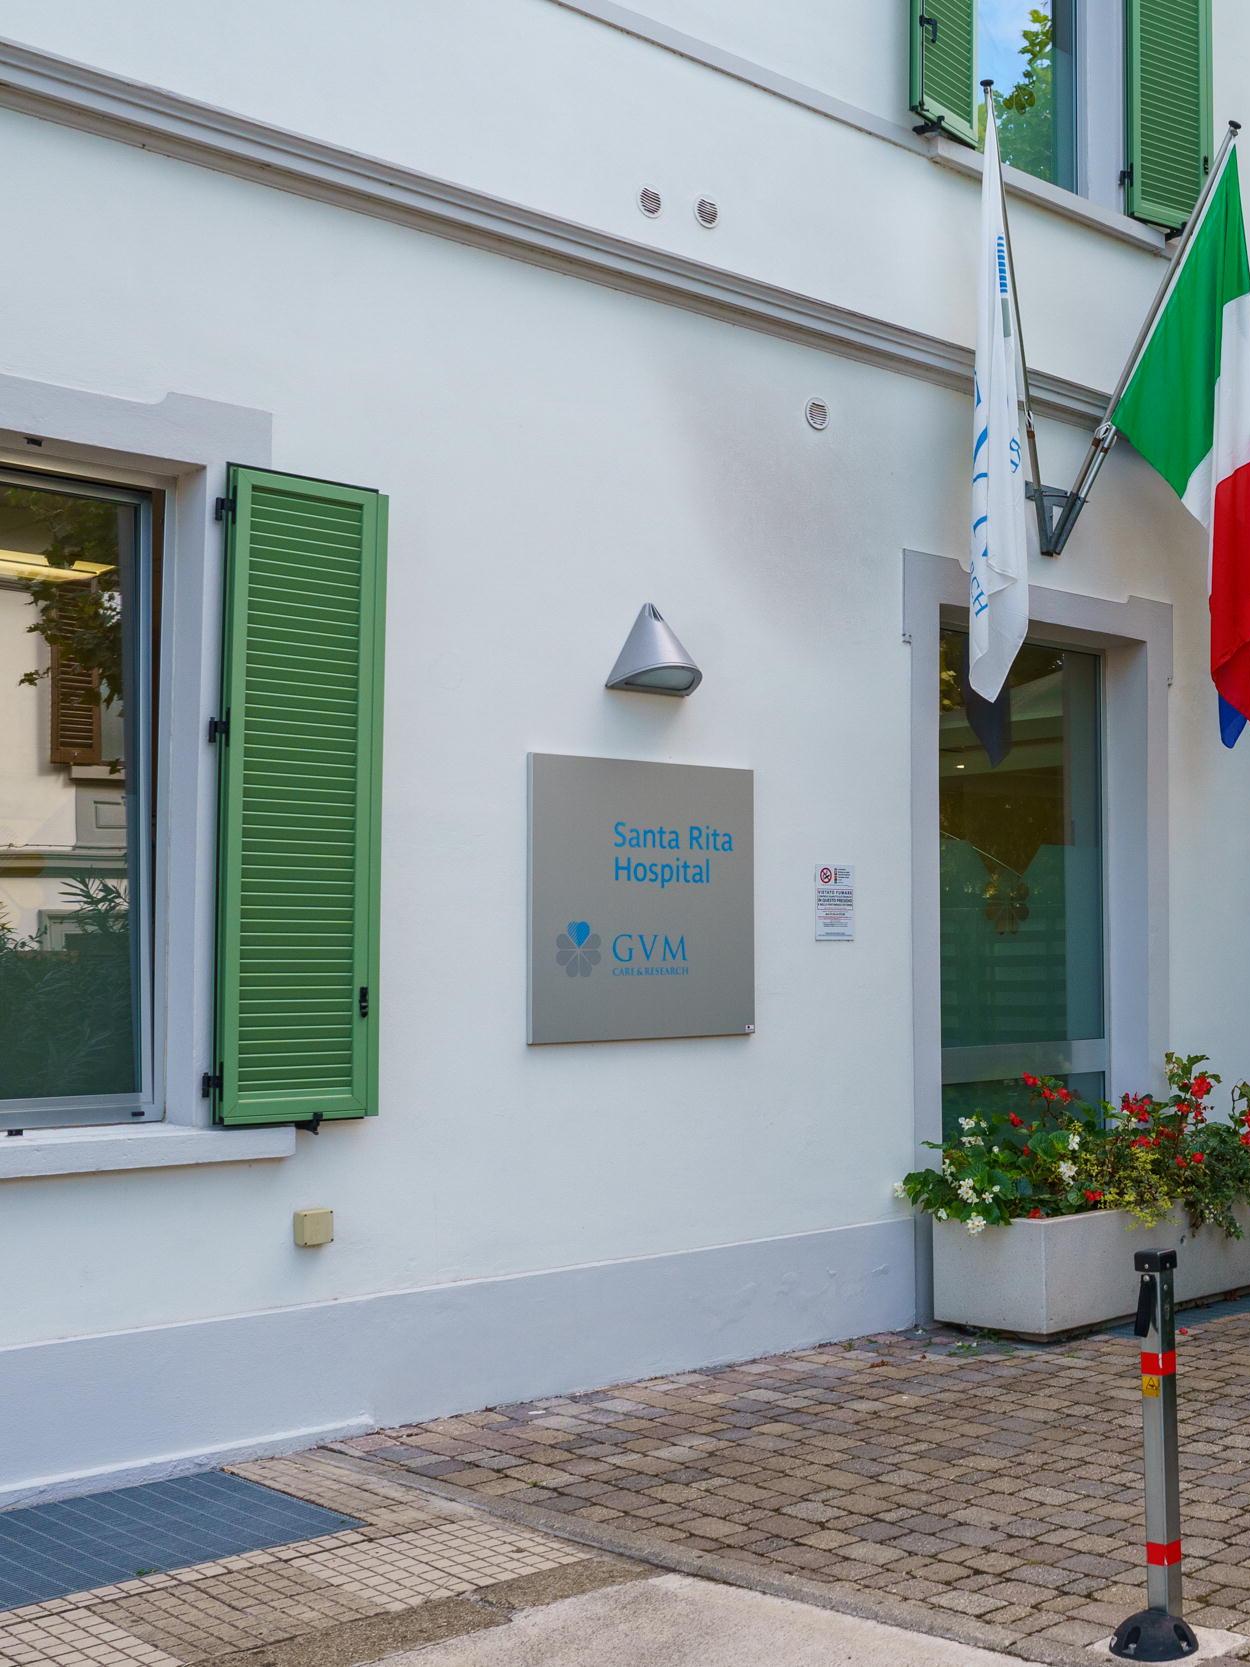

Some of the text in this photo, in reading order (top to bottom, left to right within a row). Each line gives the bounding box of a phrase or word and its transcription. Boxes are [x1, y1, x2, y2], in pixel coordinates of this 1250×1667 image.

[613, 820, 734, 852] Santa Rita
[614, 855, 711, 889] Hospital
[612, 933, 689, 963] GVM
